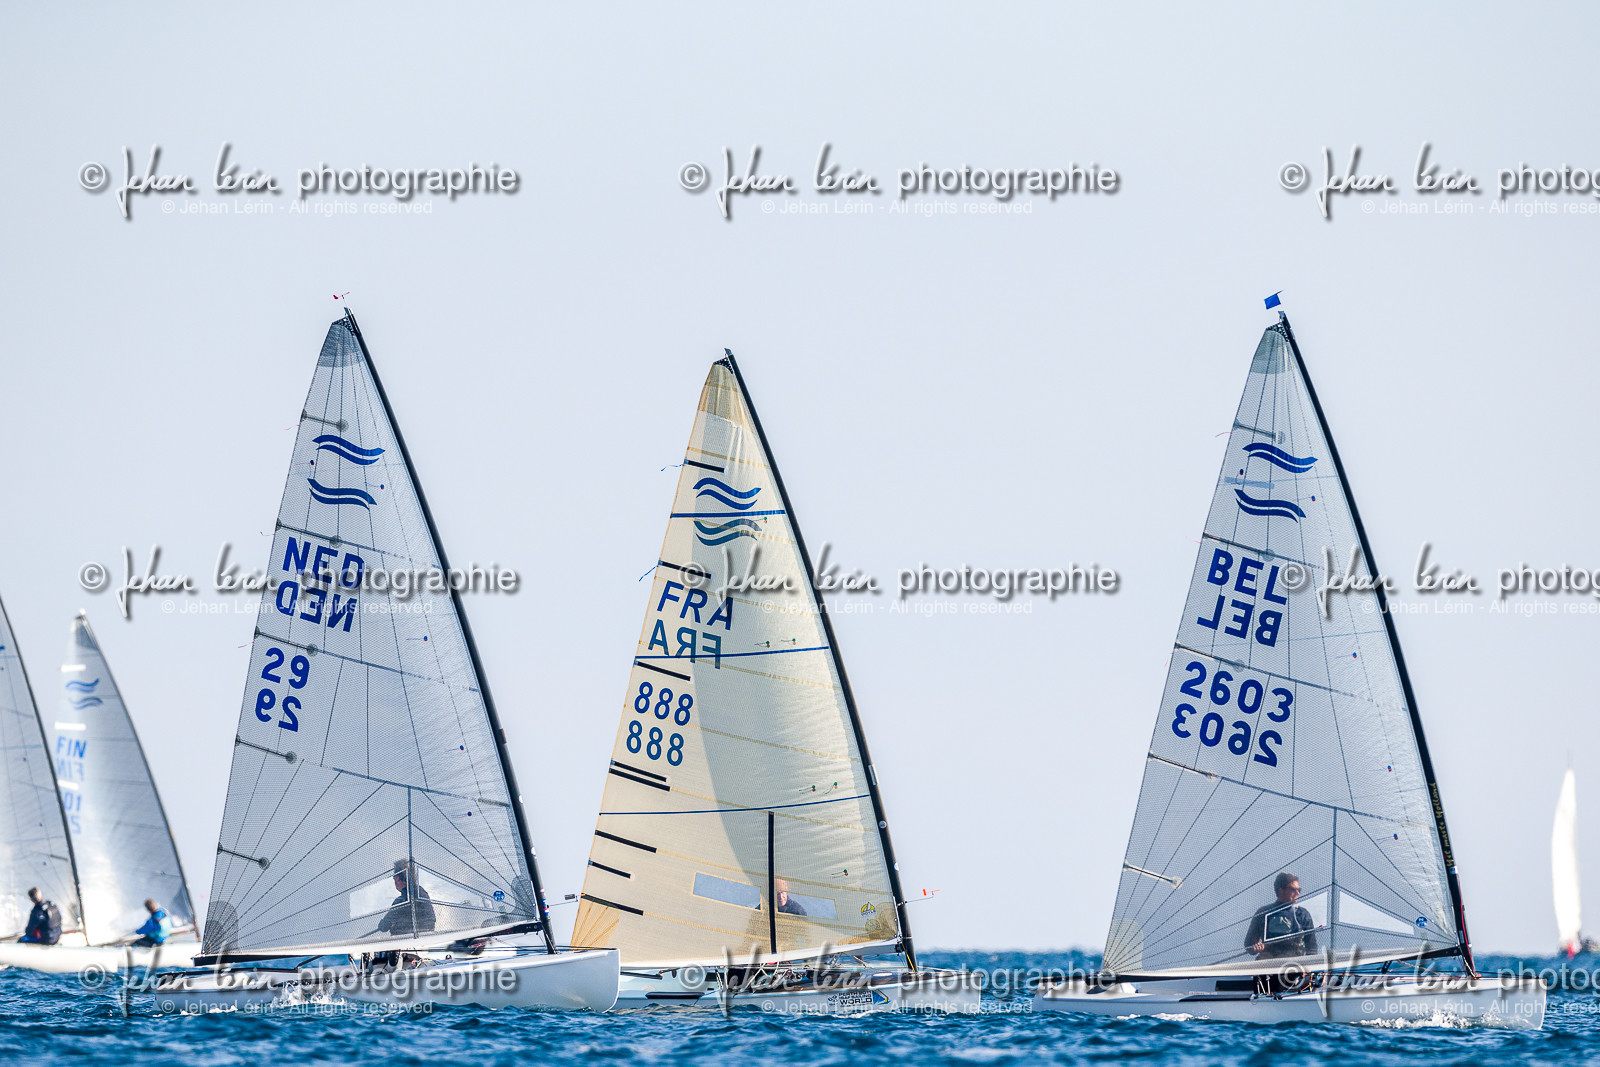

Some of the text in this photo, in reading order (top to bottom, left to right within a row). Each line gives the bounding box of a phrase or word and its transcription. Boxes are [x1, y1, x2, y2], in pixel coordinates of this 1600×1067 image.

[282, 536, 365, 589] NED
[1206, 547, 1288, 606] BEL
[656, 580, 734, 631] FRA
[261, 647, 310, 690] 29
[634, 681, 694, 726] 888
[1179, 660, 1294, 723] 2603
[56, 735, 87, 758] FIN
[63, 791, 82, 812] 01
[840, 997, 873, 1005] WORLD
